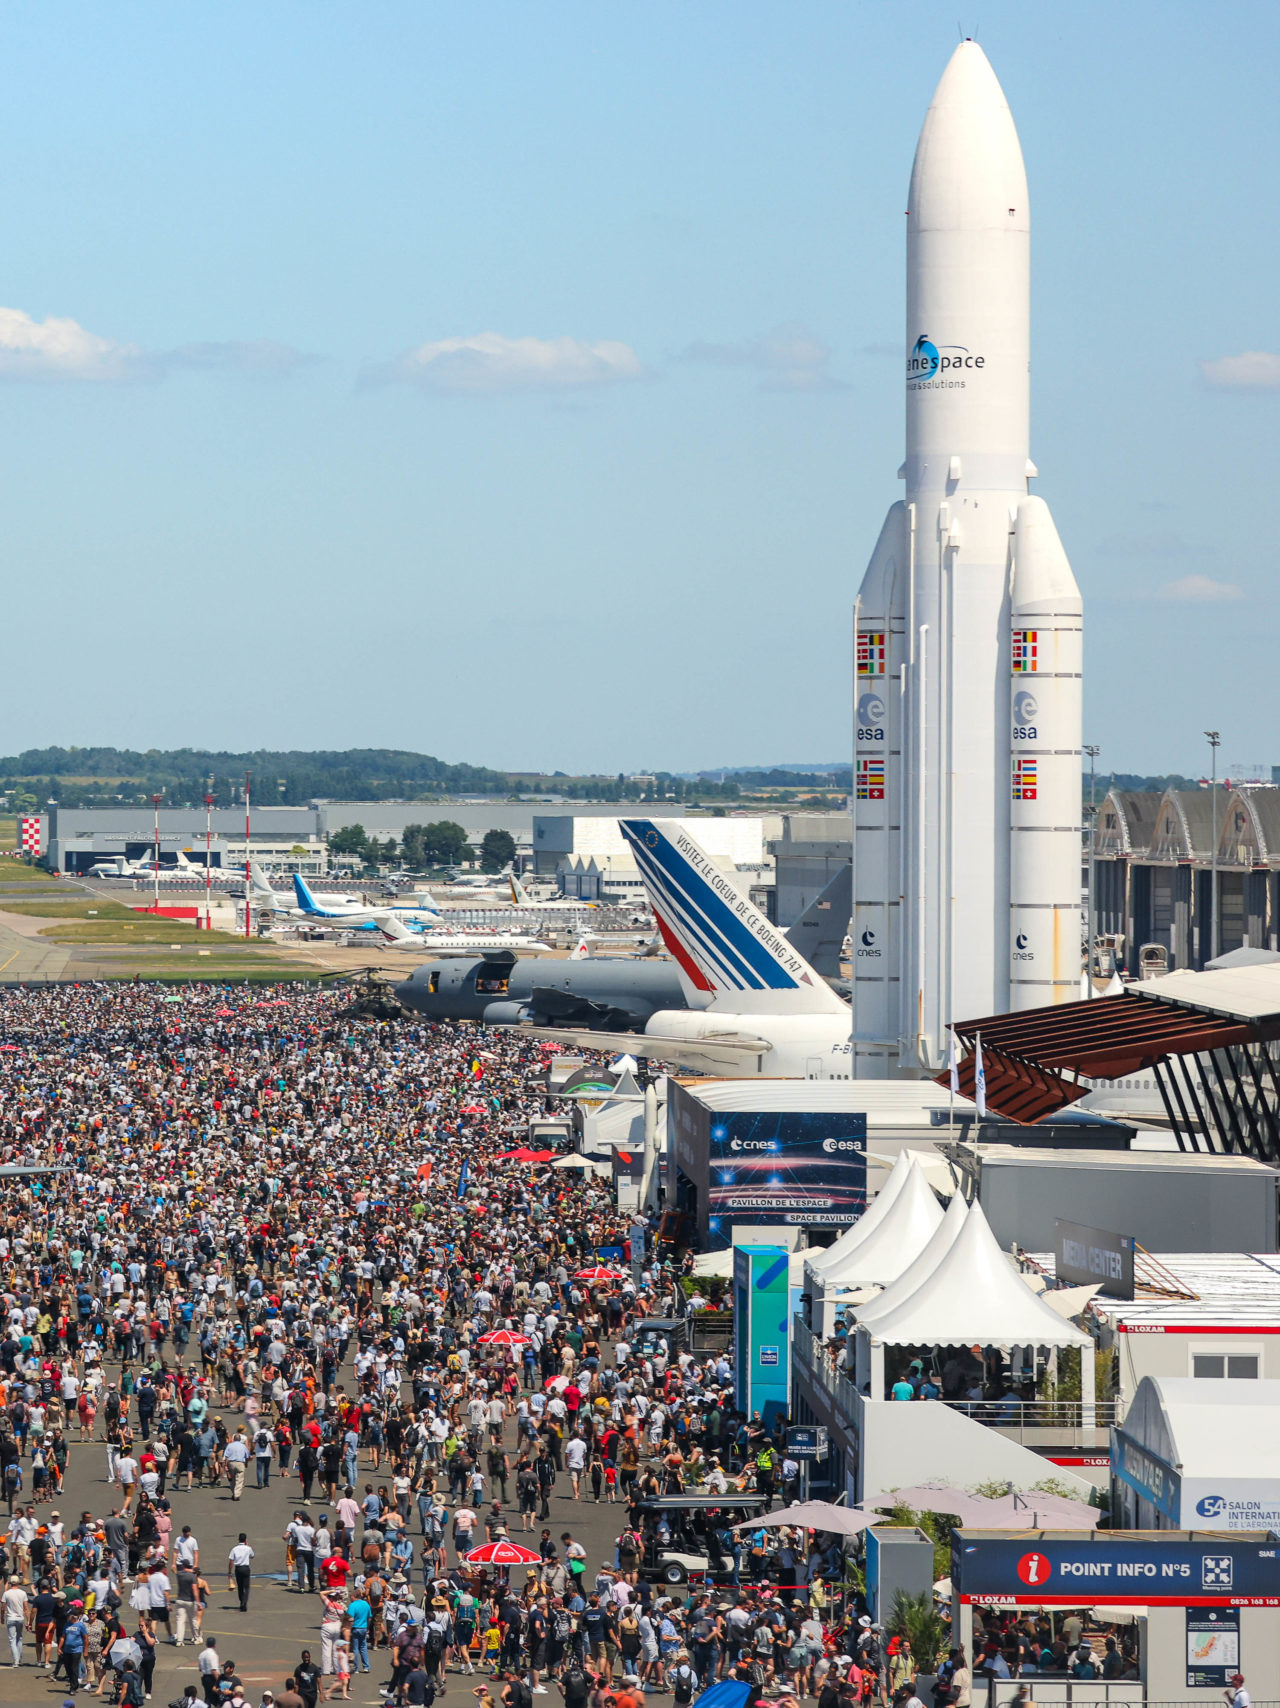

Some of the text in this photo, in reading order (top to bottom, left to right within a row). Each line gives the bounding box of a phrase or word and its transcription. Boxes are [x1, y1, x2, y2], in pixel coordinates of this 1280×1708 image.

[857, 728, 885, 741] esa
[1013, 727, 1037, 740] esa
[676, 835, 802, 973] VISITEZ LE COEUR DE CE BOEING 747
[857, 949, 882, 957] cnes
[1012, 952, 1034, 961] cnes
[831, 1044, 852, 1054] F-B
[743, 1141, 777, 1150] cnes
[838, 1141, 862, 1150] esa
[731, 1199, 829, 1207] PAVILLON DE L'ESPACE
[790, 1214, 859, 1222] SPACE PAVILION
[1088, 1246, 1122, 1280] CENTER
[1228, 1501, 1261, 1510] SALON
[1060, 1562, 1191, 1577] POINT INFO N°5
[979, 1596, 1017, 1604] LOXAM
